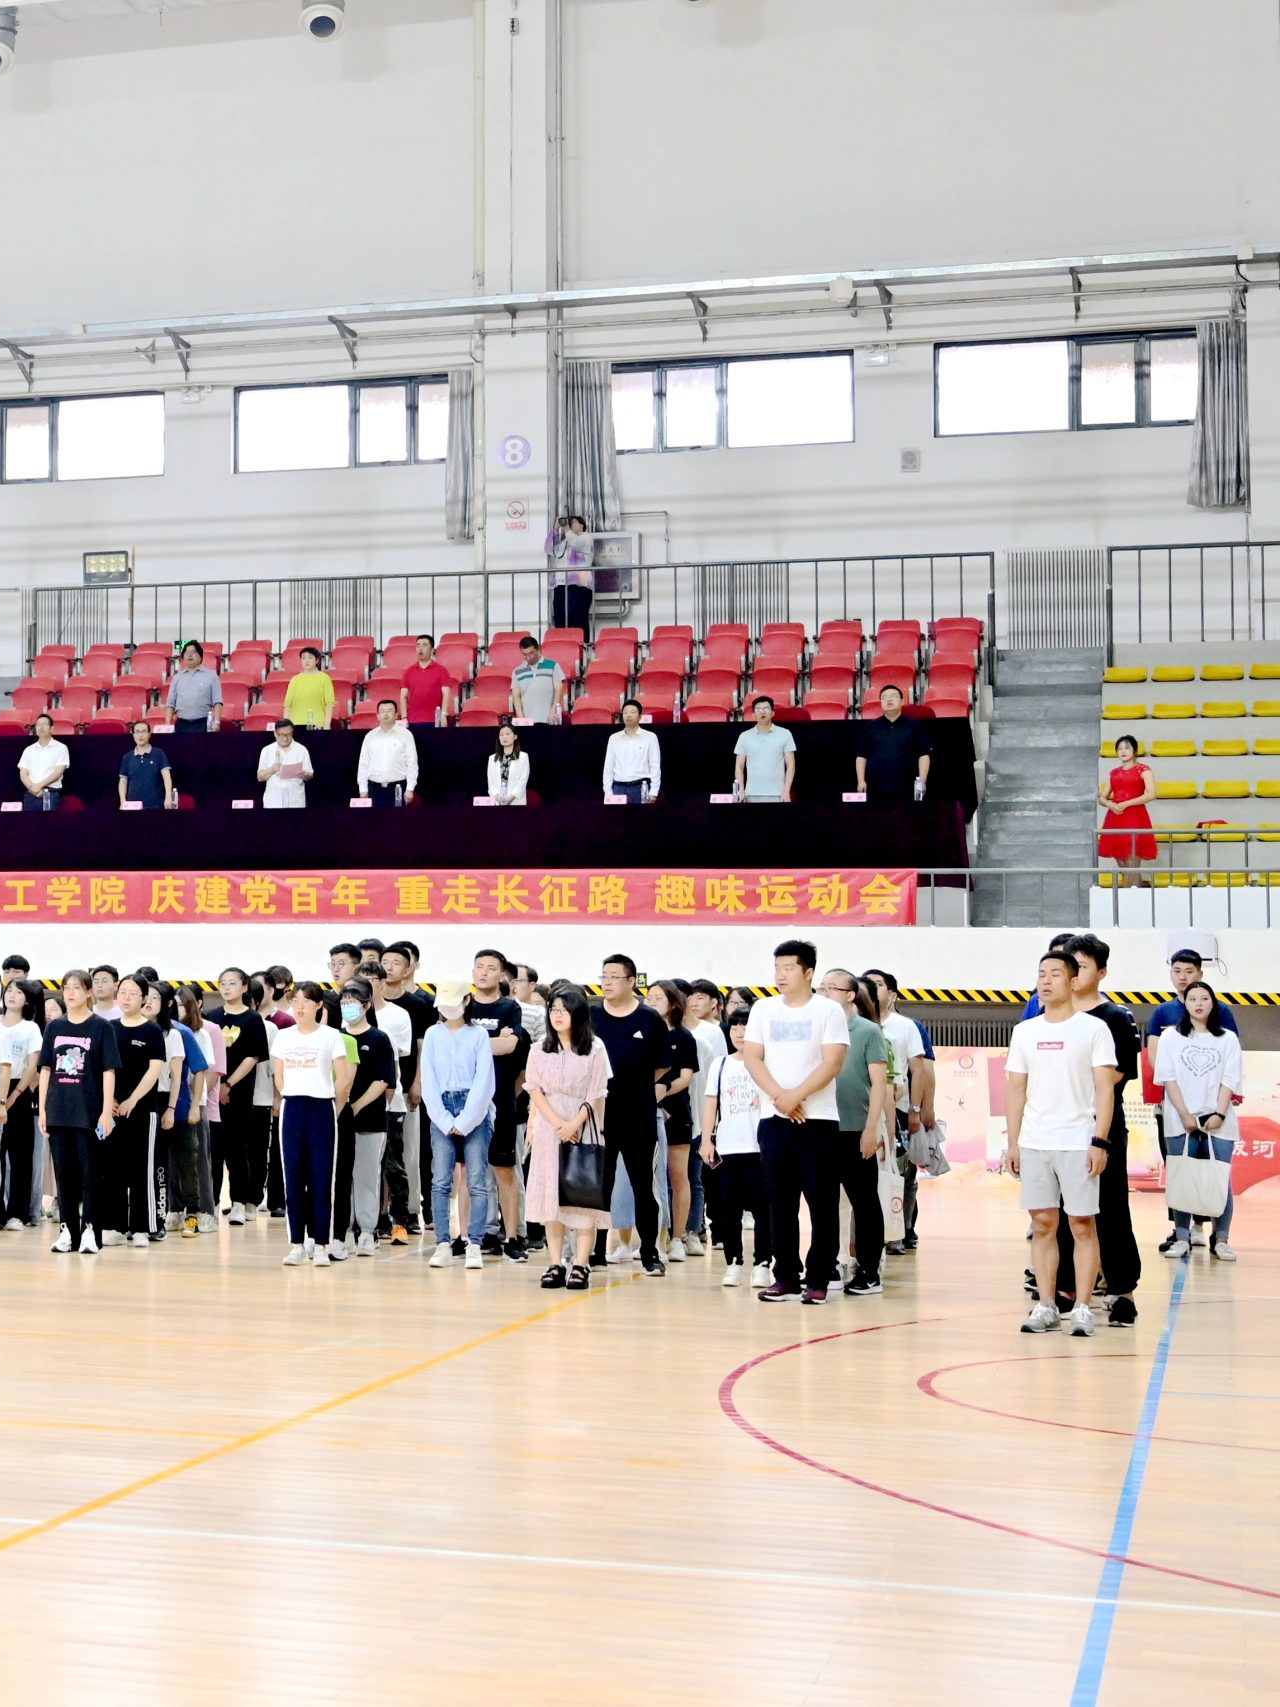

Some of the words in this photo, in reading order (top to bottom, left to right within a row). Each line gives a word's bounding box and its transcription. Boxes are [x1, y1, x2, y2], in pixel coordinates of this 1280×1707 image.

[504, 438, 524, 465] 8
[148, 875, 370, 915] 庆建党百年
[394, 874, 629, 915] 重走长征路
[654, 873, 902, 916] 趣味运动会
[157, 1166, 167, 1187] neo
